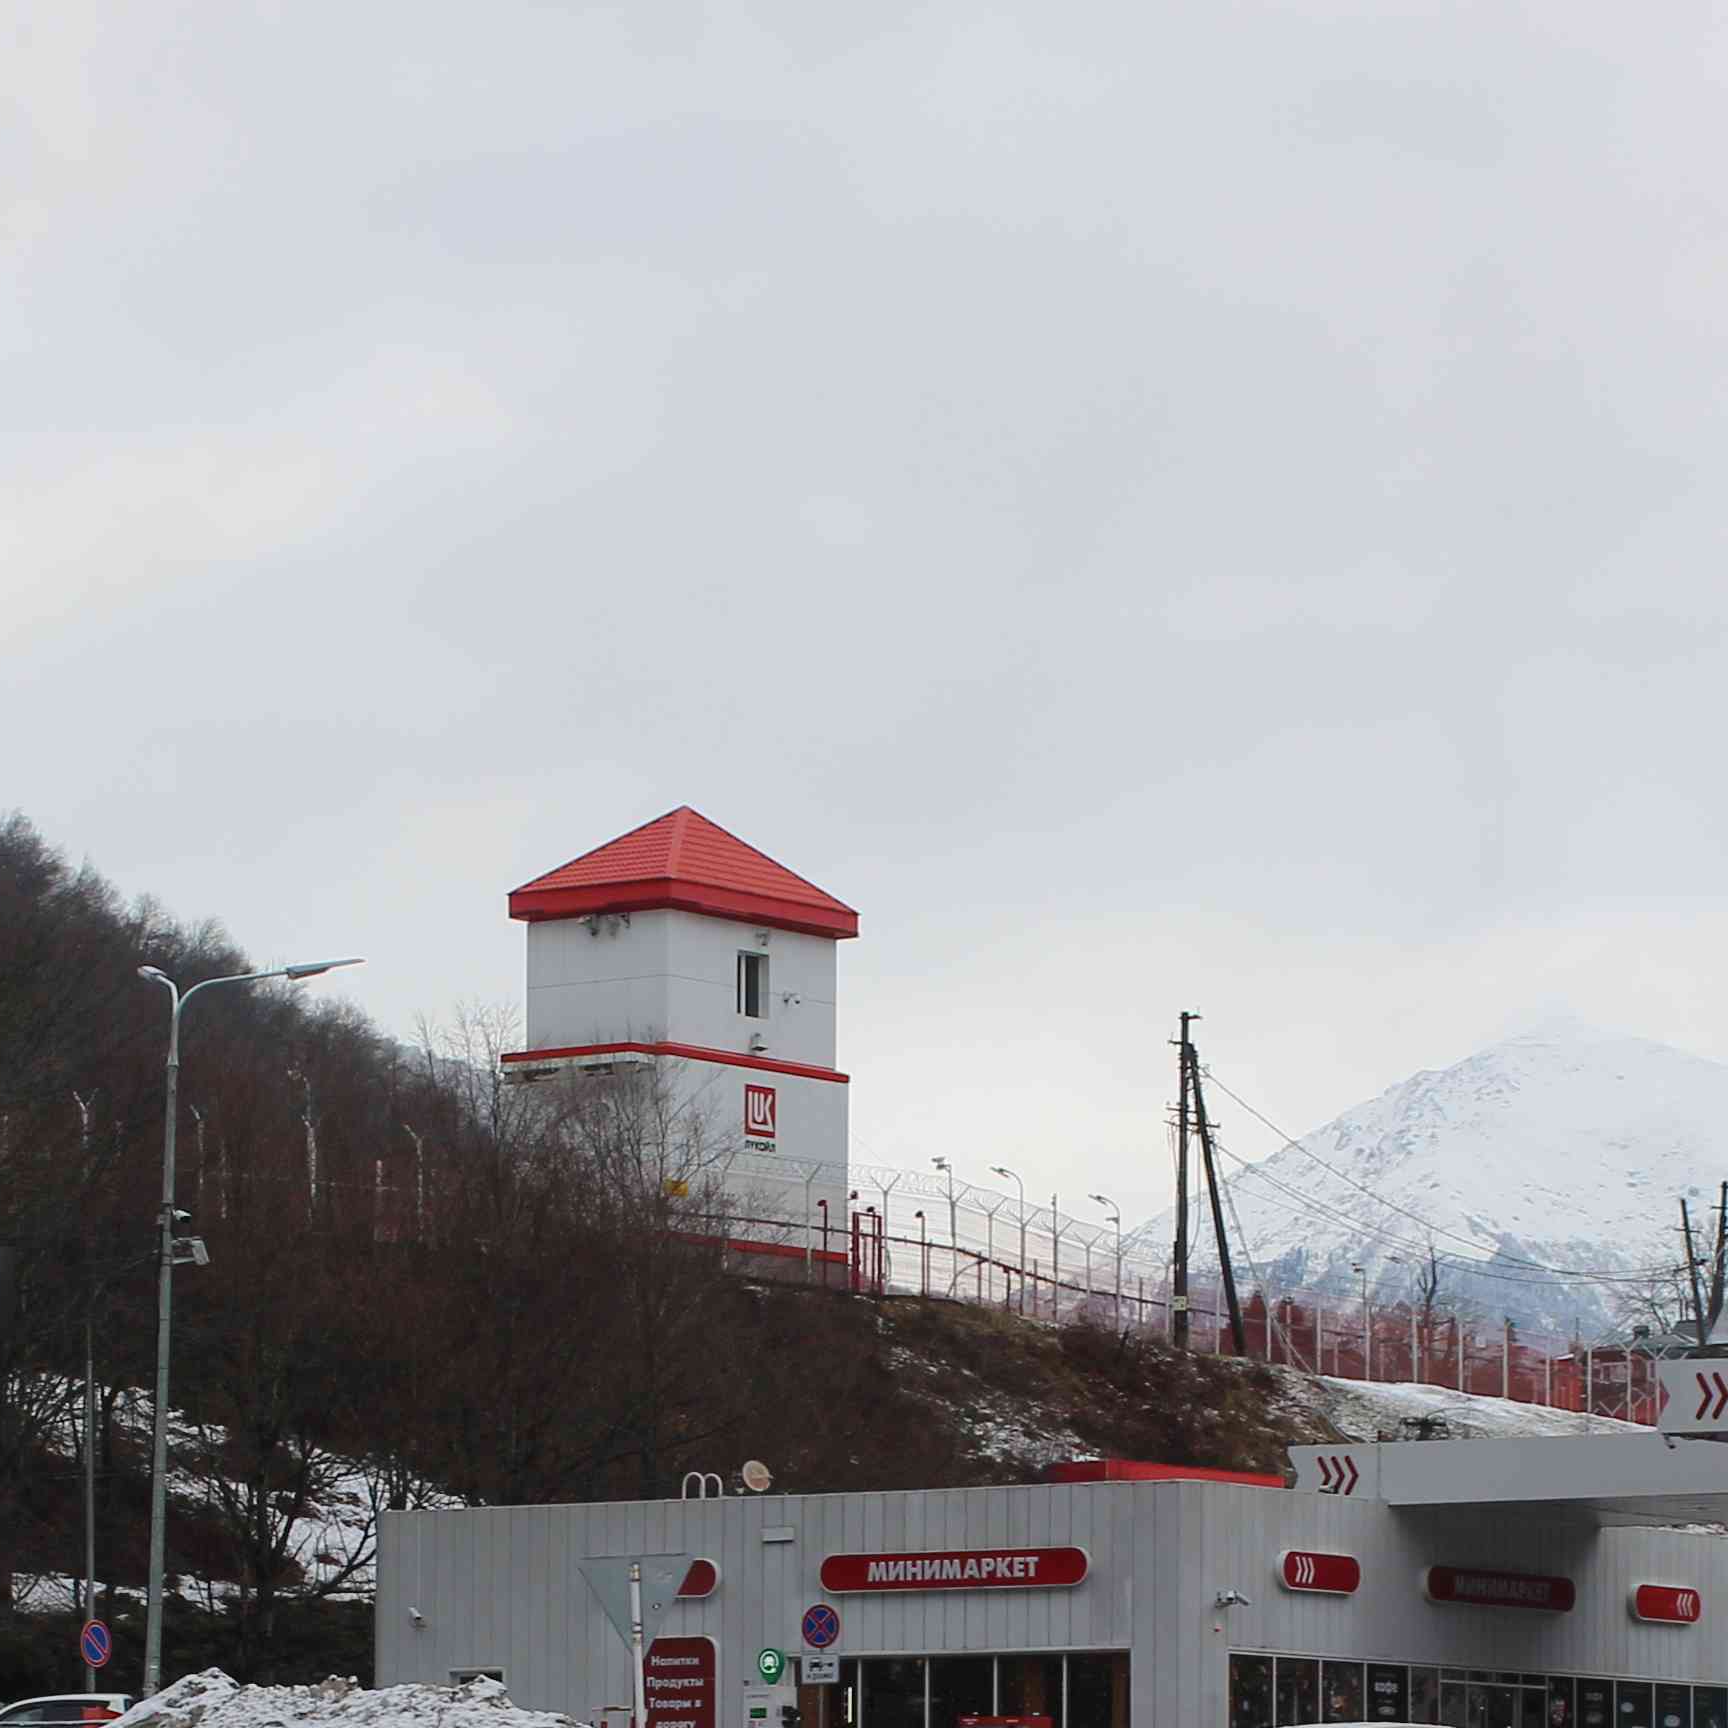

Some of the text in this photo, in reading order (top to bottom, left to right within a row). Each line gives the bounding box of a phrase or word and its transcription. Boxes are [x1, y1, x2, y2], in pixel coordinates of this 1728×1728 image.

[867, 1556, 1040, 1582] МИНИМАРКЕТ
[646, 1676, 704, 1690] Продукты
[648, 1697, 691, 1711] Товары
